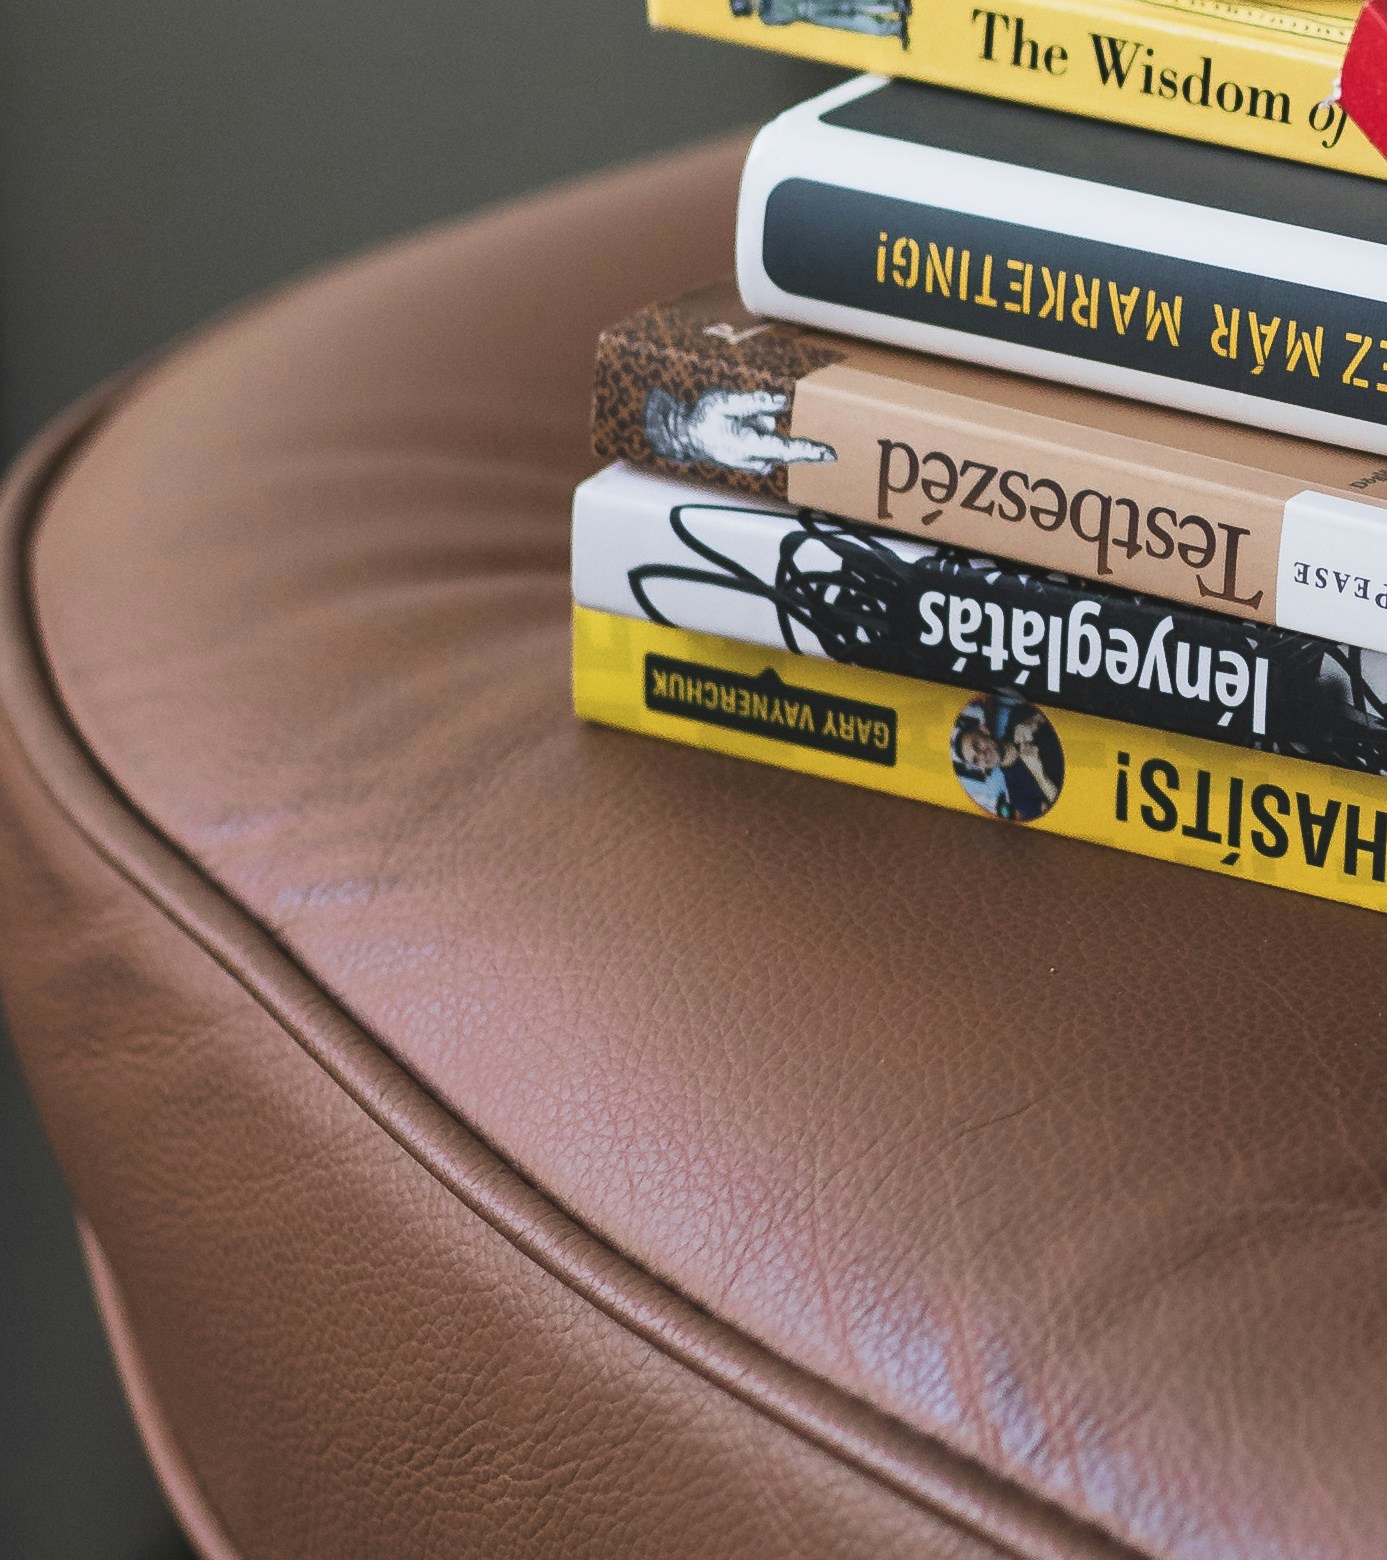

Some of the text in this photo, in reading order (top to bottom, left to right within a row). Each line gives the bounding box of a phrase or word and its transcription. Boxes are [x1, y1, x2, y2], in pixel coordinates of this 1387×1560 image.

[972, 8, 1068, 76] The
[1088, 32, 1292, 125] Wisdom
[876, 231, 1183, 347] MARKETING!
[1210, 303, 1324, 378] MÁR
[877, 438, 1265, 610] Testbeszéd
[652, 667, 890, 751] GARY VAYNERCHUK
[918, 590, 1270, 735] lényeglátás
